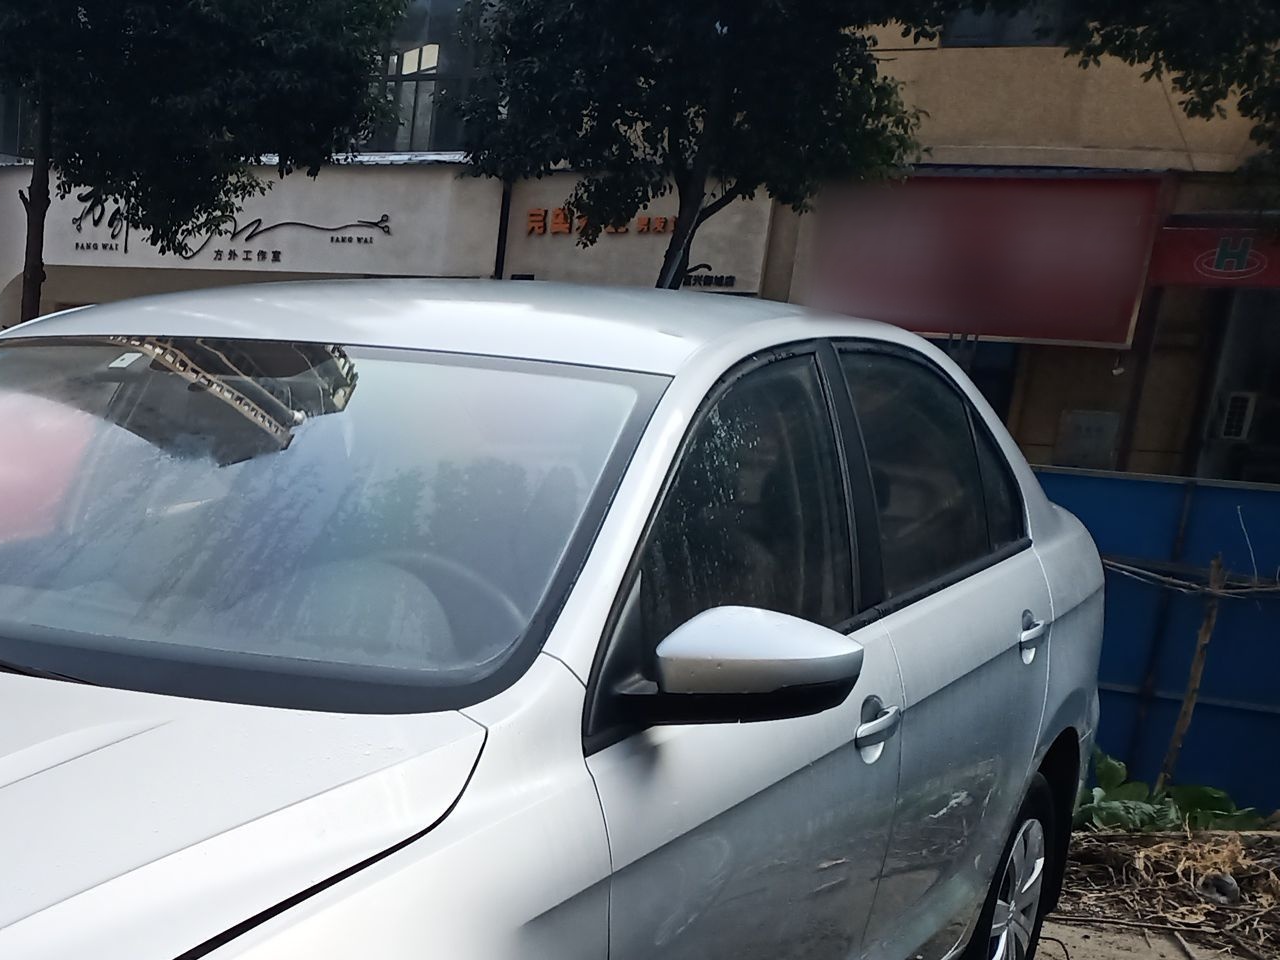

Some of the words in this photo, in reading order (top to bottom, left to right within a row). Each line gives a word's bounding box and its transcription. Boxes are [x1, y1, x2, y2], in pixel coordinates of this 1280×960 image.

[75, 242, 98, 250] FANG
[213, 249, 282, 262] 方外工作室
